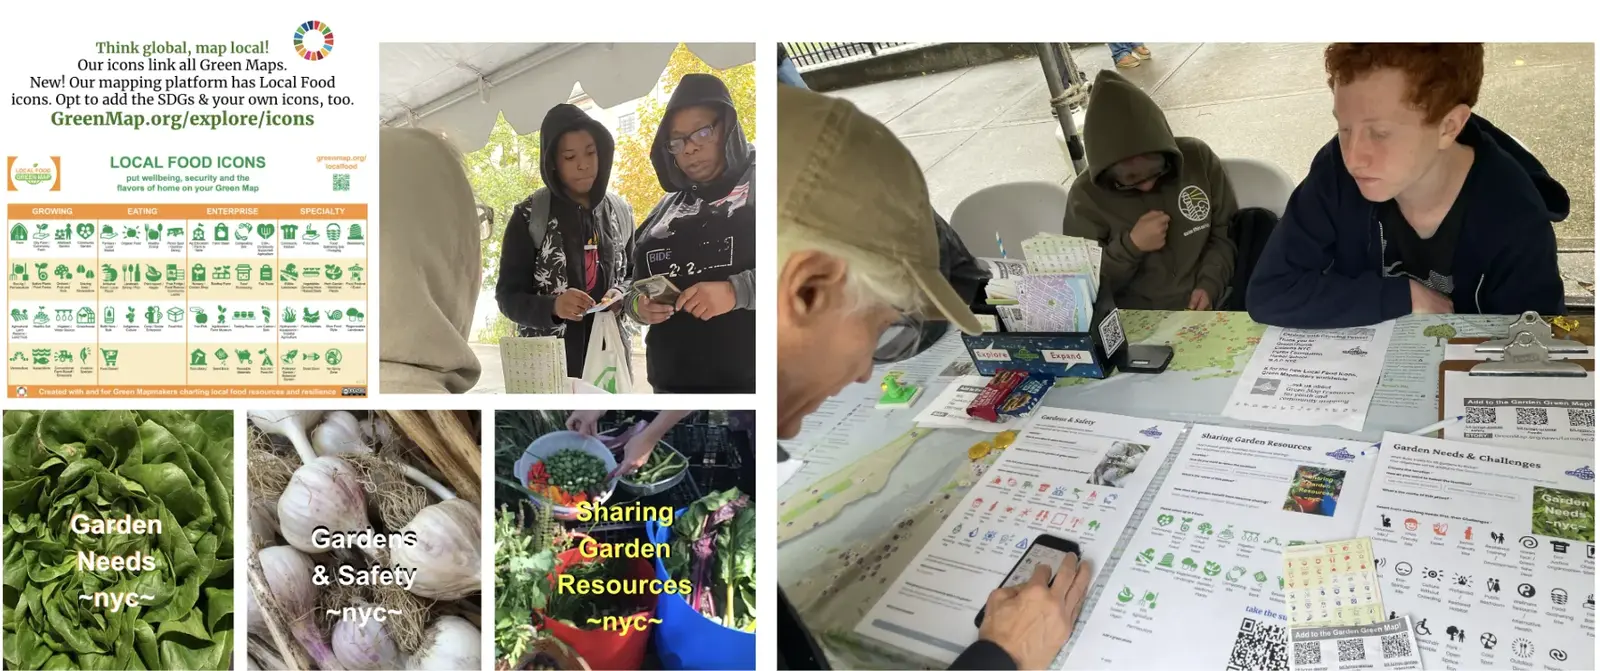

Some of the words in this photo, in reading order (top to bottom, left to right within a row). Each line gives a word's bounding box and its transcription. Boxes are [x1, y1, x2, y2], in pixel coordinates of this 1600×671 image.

[96, 41, 140, 54] Think
[143, 41, 191, 57] global,
[195, 44, 227, 57] map
[231, 40, 268, 54] local!
[78, 59, 104, 71] Our
[107, 58, 144, 71] icons
[148, 58, 176, 71] link
[179, 58, 196, 71] all
[200, 59, 242, 71] Green
[245, 59, 287, 74] Maps.
[30, 75, 65, 88] New!
[69, 76, 96, 88] Our
[99, 76, 162, 92] mapping
[165, 75, 228, 92] platform
[231, 76, 256, 88] has
[260, 76, 297, 88] Local
[301, 76, 335, 88] Food
[11, 93, 52, 105] icons.
[56, 94, 81, 109] Opt
[84, 94, 98, 105] to
[102, 93, 127, 105] add
[132, 93, 154, 105] the
[158, 93, 195, 105] SDGs
[198, 94, 209, 105] &
[212, 96, 245, 109] your
[248, 96, 278, 105] own
[282, 93, 323, 108] icons,
[328, 94, 354, 105] too.
[51, 110, 314, 130] GreenMap.org/explore/icons
[110, 156, 163, 168] LOCAL
[168, 156, 212, 168] FOOD
[217, 156, 266, 168] ICONS
[326, 162, 358, 170] localfood
[126, 175, 140, 183] put
[142, 174, 183, 183] wellbeing,
[185, 174, 217, 183] security
[215, 184, 240, 192] Green
[242, 184, 259, 193] Map
[1050, 352, 1082, 360] Expand
[137, 388, 177, 396] Mapmakers
[180, 388, 209, 396] charting
[1074, 417, 1096, 425] Safety
[1201, 433, 1233, 443] Sharing
[1235, 436, 1265, 445] Garden
[1267, 440, 1312, 451] Resources
[1393, 444, 1430, 454] Garden
[1433, 448, 1465, 459] Needs
[1479, 455, 1541, 469] Challenges
[1542, 492, 1590, 507] Garden
[576, 501, 674, 524] Sharing
[1545, 504, 1586, 519] Needs
[71, 514, 162, 534] Garden
[311, 529, 417, 550] Gardens
[578, 538, 671, 558] Garden
[78, 551, 156, 572] Needs
[312, 566, 330, 586] &
[338, 566, 417, 590] Safety
[558, 575, 692, 595] Resources
[79, 591, 155, 612] ~nyc~
[326, 606, 402, 628] ~nyc~
[1246, 606, 1262, 615] take
[1264, 610, 1277, 618] the
[586, 617, 663, 636] ~nyc~
[1384, 622, 1401, 631] Map!
